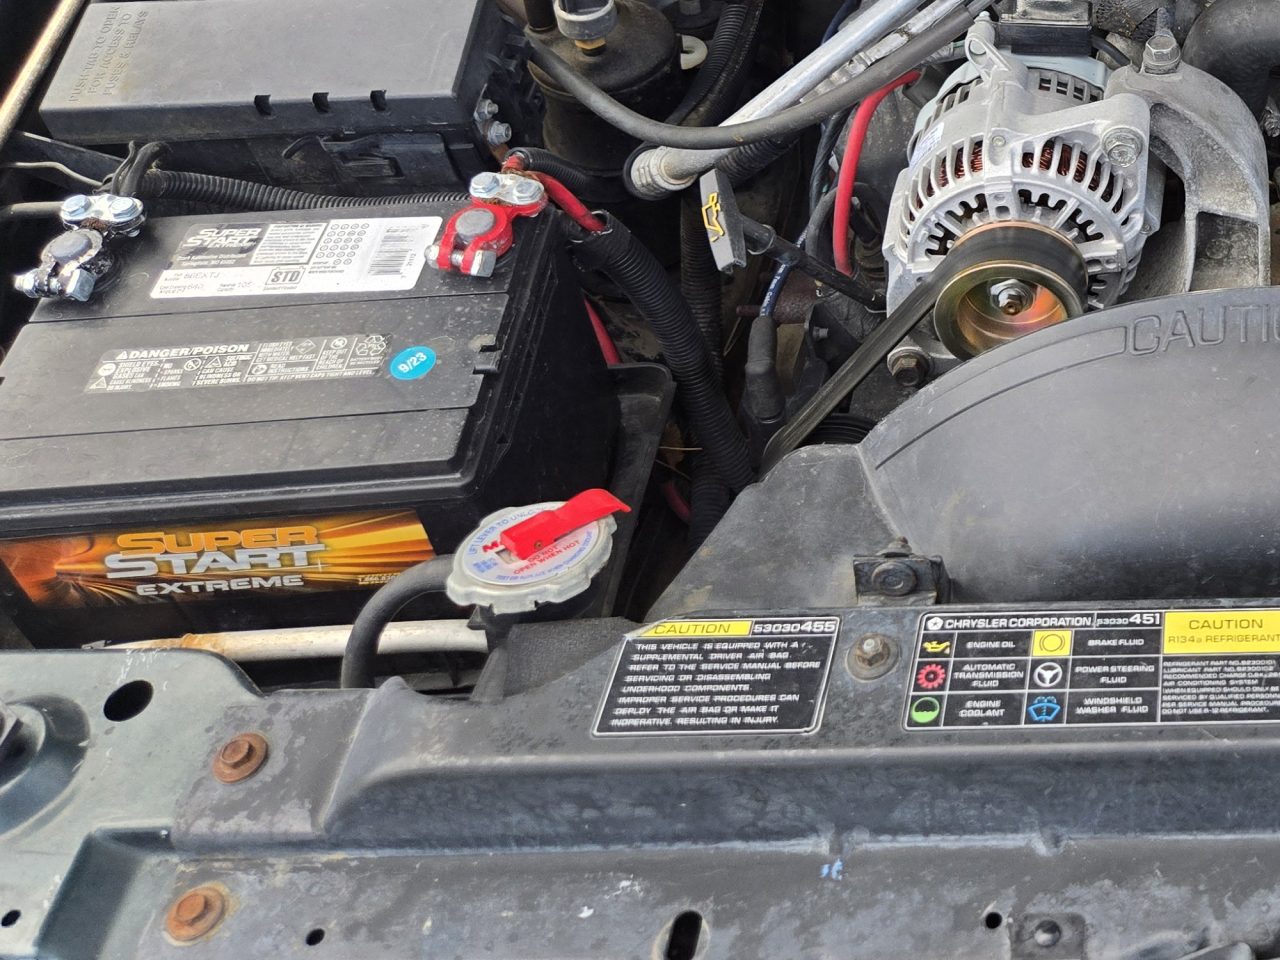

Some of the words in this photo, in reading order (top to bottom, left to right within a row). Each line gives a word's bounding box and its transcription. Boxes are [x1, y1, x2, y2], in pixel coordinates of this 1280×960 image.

[101, 6, 120, 33] OPEN
[103, 63, 128, 95] FUSES
[124, 11, 148, 49] RELAYS
[198, 227, 262, 238] SUPER
[183, 236, 252, 248] START
[271, 269, 302, 283] STD
[128, 344, 250, 359] DANGER/POISON
[397, 352, 427, 374] 9/23
[117, 525, 319, 556] SUPER
[104, 544, 325, 579] START
[513, 561, 538, 575] OPEN
[538, 549, 562, 565] WHEN
[563, 540, 580, 551] HOT
[136, 575, 304, 596] EXTREME
[753, 621, 837, 634] 53030455
[945, 618, 1008, 629] CHRYSLER
[1008, 616, 1092, 627] CORPORATION
[1189, 619, 1263, 630] CAUTION
[654, 624, 731, 634] CAUTION
[1168, 635, 1202, 643] R134a
[1206, 634, 1280, 643] REFRIGERANT
[660, 642, 698, 650] VEHICLE
[703, 642, 713, 650] IS
[715, 642, 760, 650] EQUIPPED
[966, 641, 1000, 649] ENGINE
[632, 653, 704, 661] SUPPLEMENTAL
[708, 652, 743, 660] DRIVER
[742, 662, 782, 670] MANUAL
[962, 663, 1016, 671] AUTOMATIC
[953, 671, 1024, 679] TRANSMISSION
[617, 696, 667, 704] IMPROPER
[712, 694, 777, 702] PROCEDURES
[965, 700, 1001, 708] ENGINE
[1083, 697, 1142, 705] WINDSHIELD
[613, 707, 652, 715] DEPLOY
[679, 706, 697, 714] AIR
[739, 705, 767, 713] MAKE
[959, 709, 1005, 717] COOLANT
[1075, 706, 1116, 714] WASHER
[1120, 705, 1148, 713] FLUID
